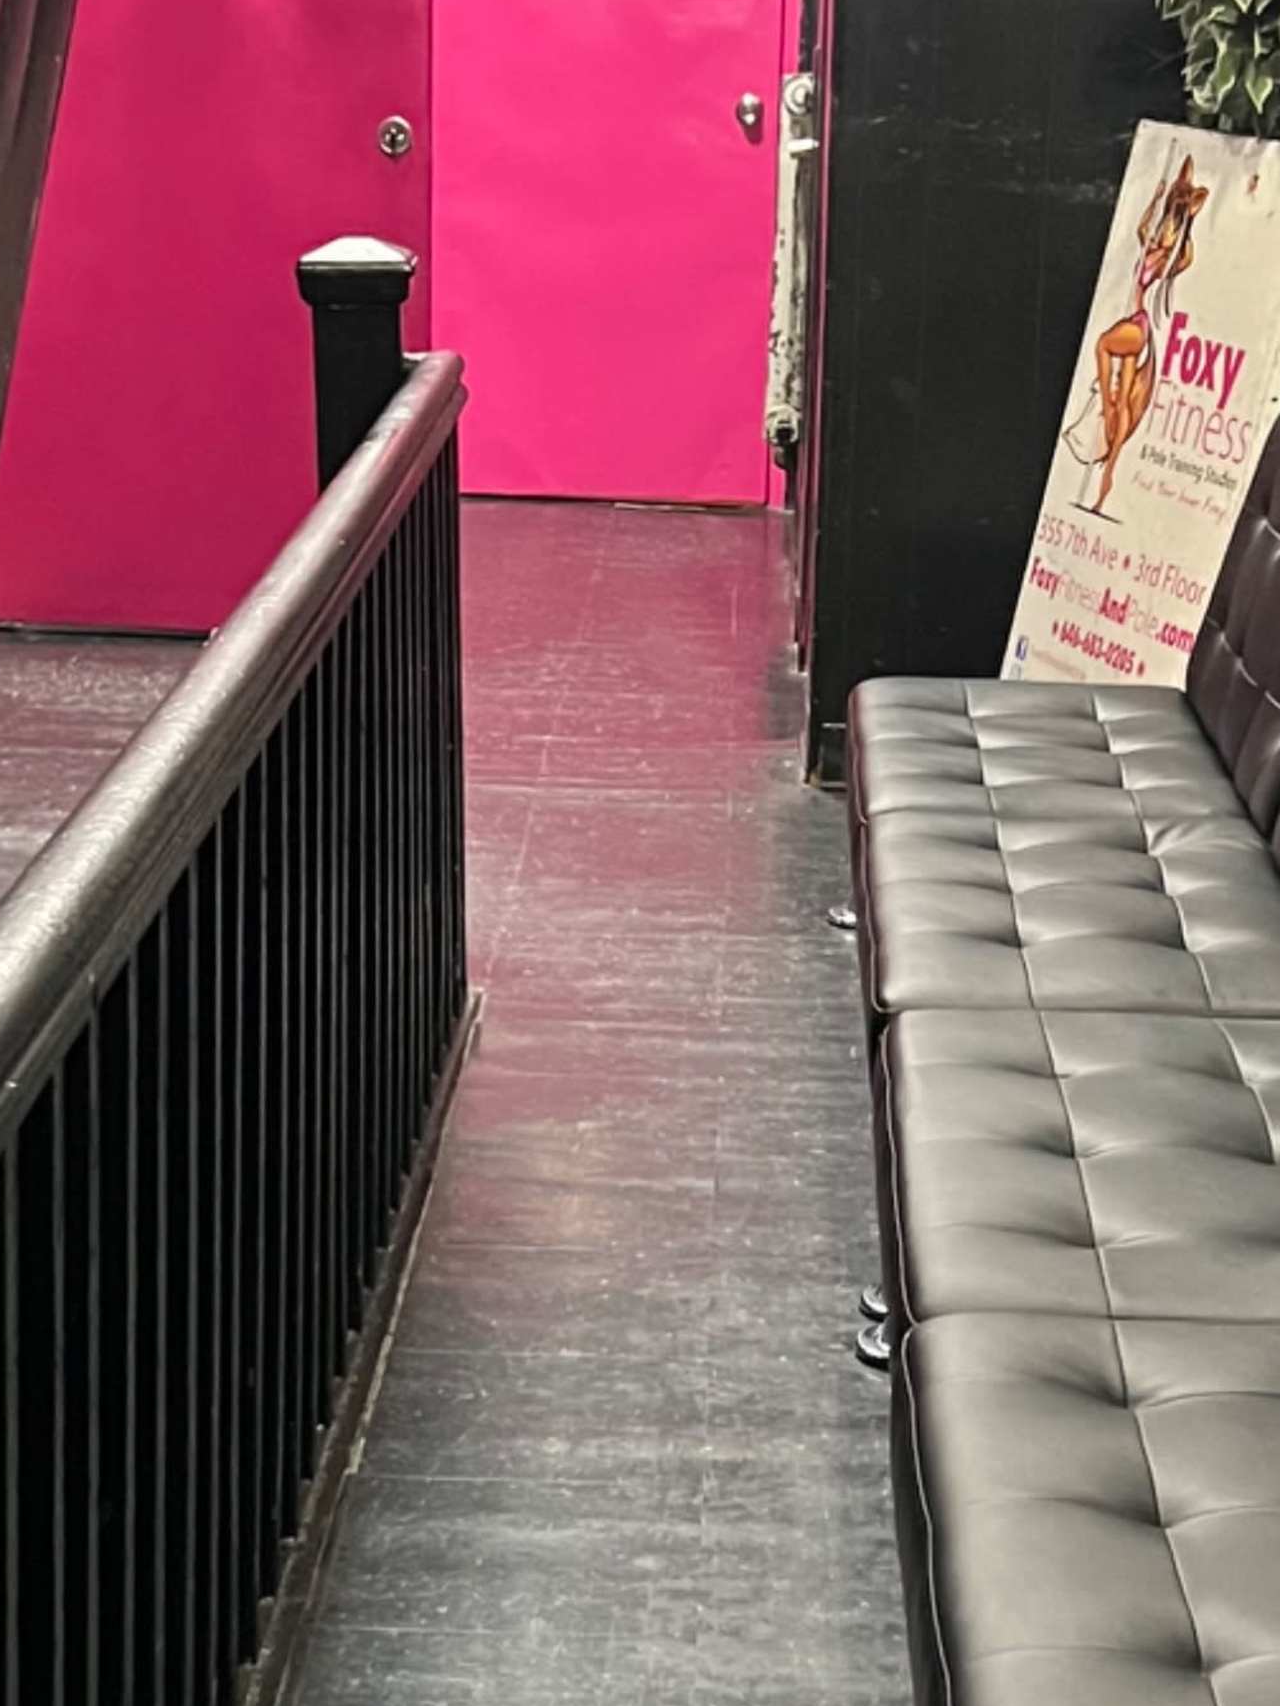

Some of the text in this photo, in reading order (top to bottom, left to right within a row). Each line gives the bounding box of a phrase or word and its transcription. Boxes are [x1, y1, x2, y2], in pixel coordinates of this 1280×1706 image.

[1161, 311, 1246, 410] Foxy
[1147, 380, 1252, 465] Fitness
[1038, 515, 1207, 604] 355 7th Ave 3rd Floor
